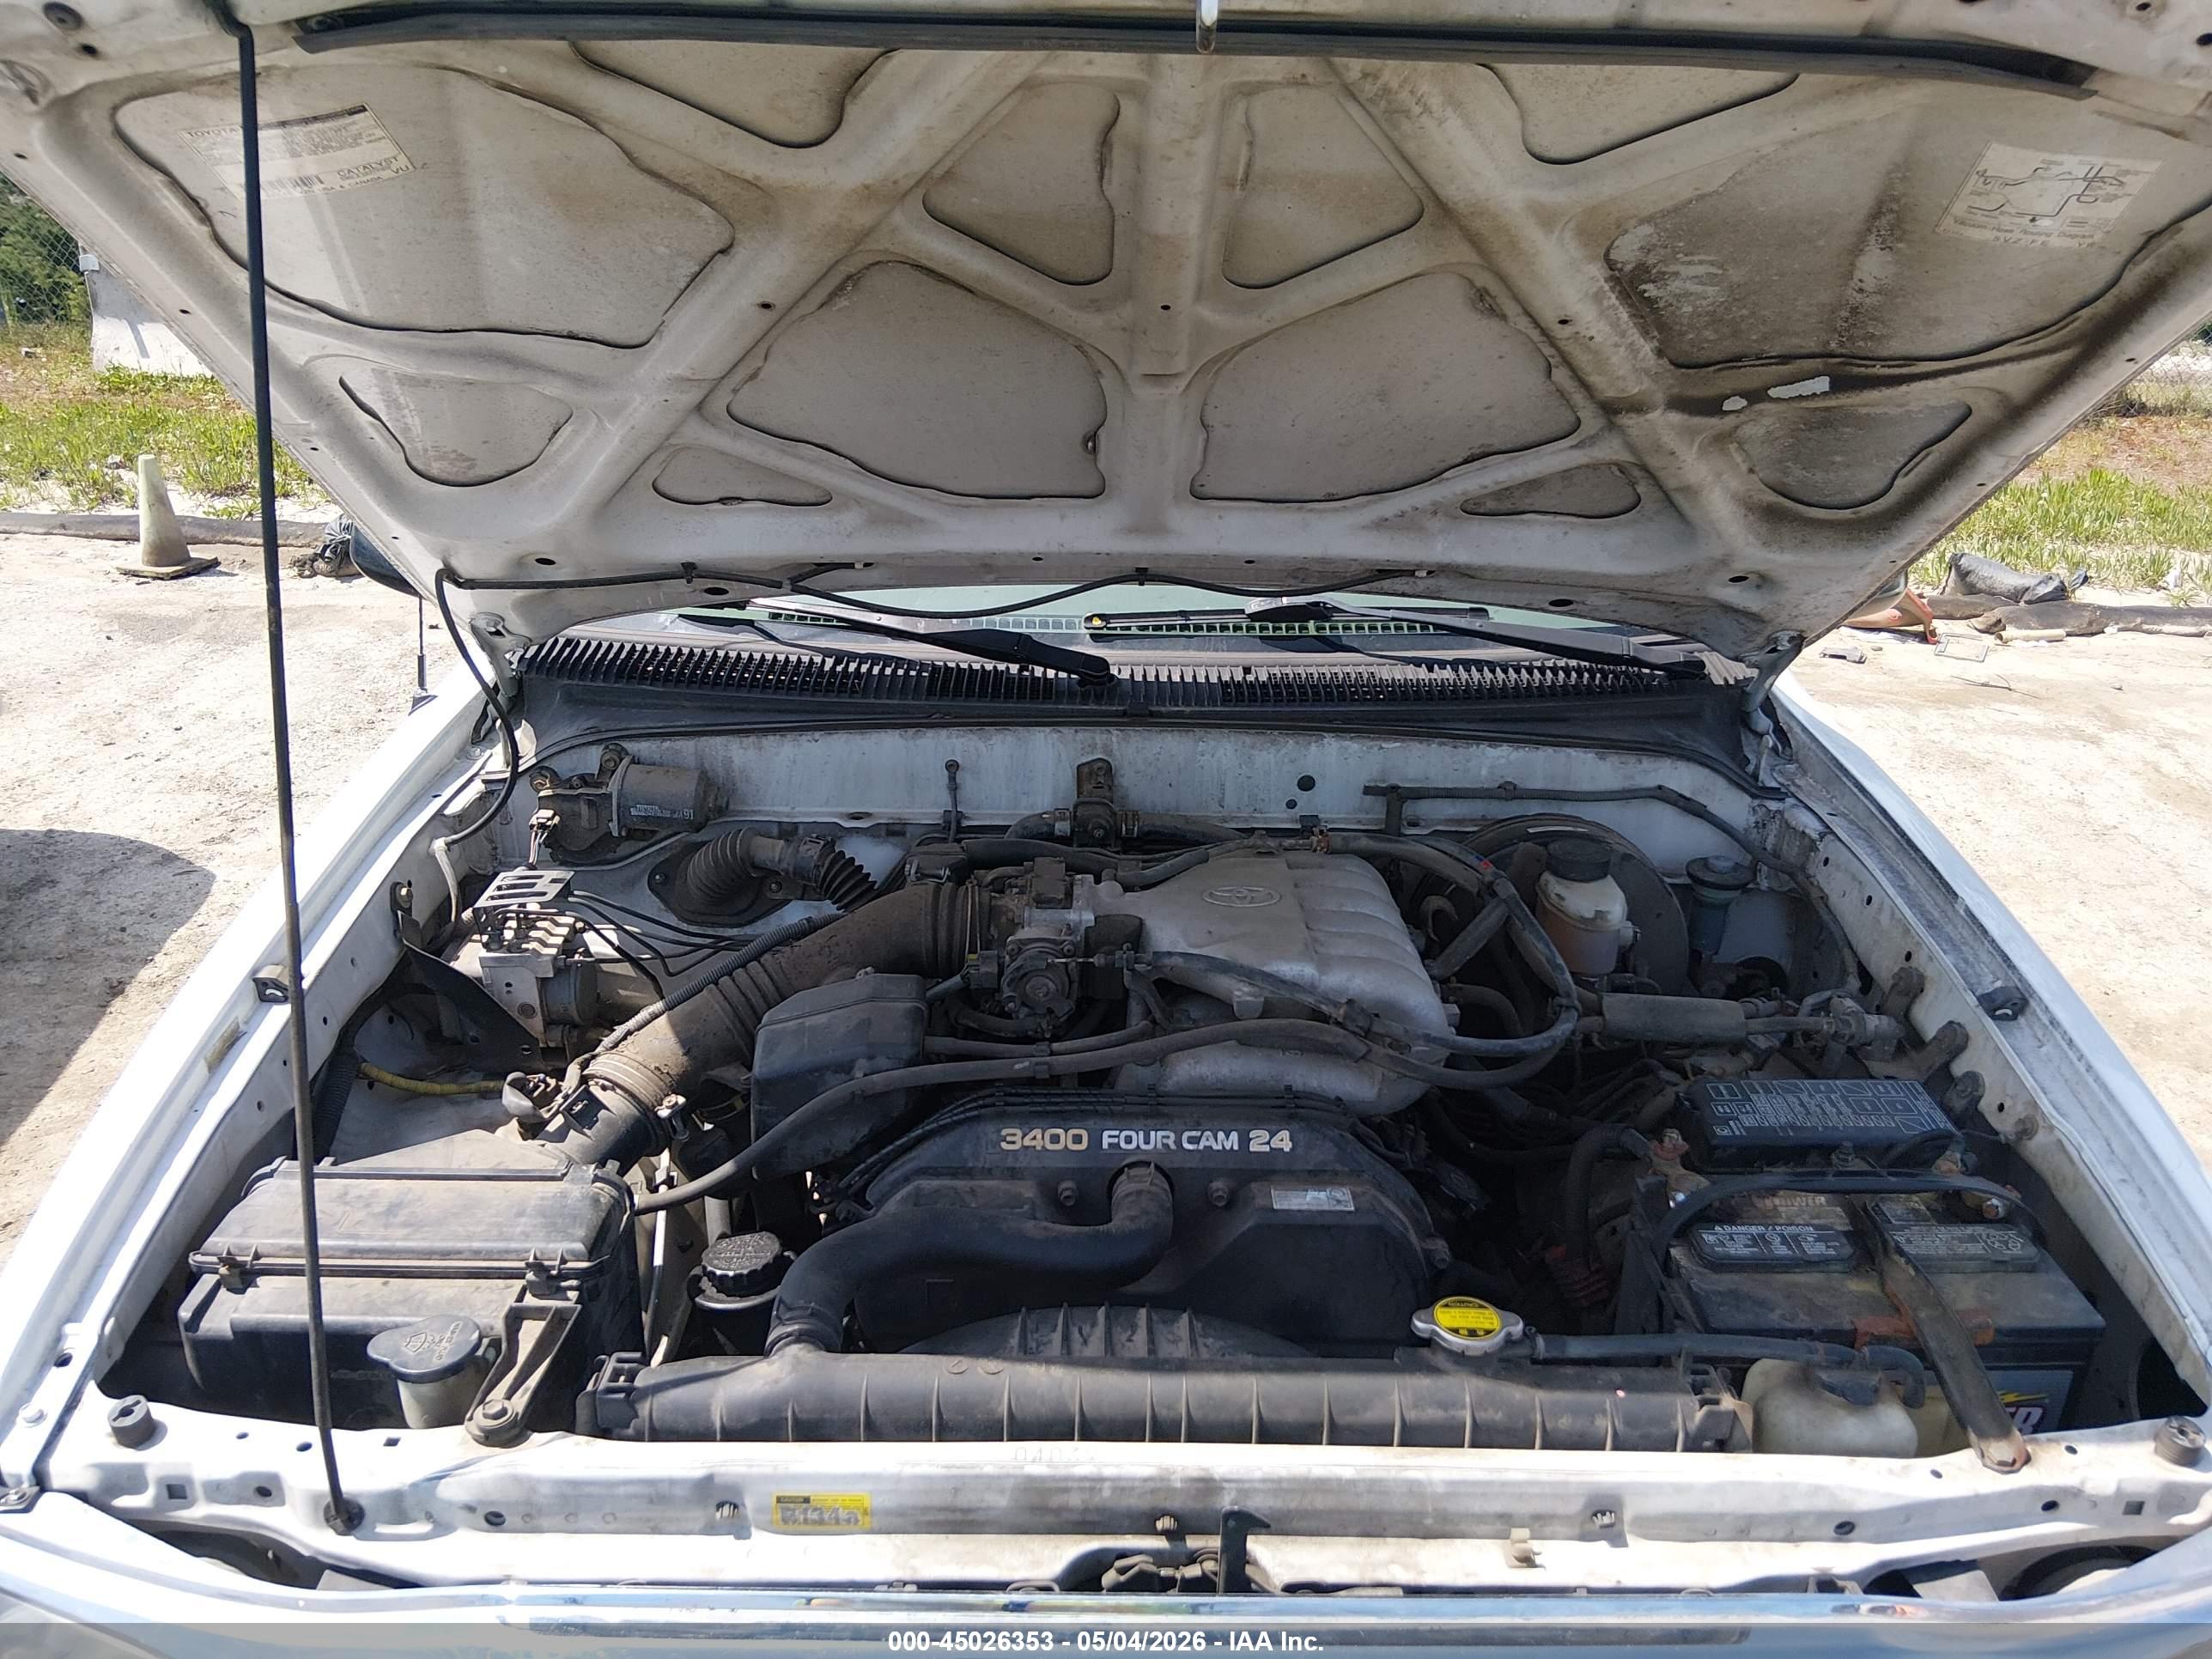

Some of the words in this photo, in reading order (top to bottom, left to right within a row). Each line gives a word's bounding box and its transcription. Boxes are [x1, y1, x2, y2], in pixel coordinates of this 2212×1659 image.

[188, 128, 240, 137] TOYOTA
[337, 155, 399, 176] CATALYST
[391, 164, 410, 174] VU
[1000, 1127, 1089, 1152] 3400
[1102, 1130, 1176, 1151] FOUR
[1181, 1130, 1239, 1151] CAM
[1249, 1129, 1292, 1152] 24
